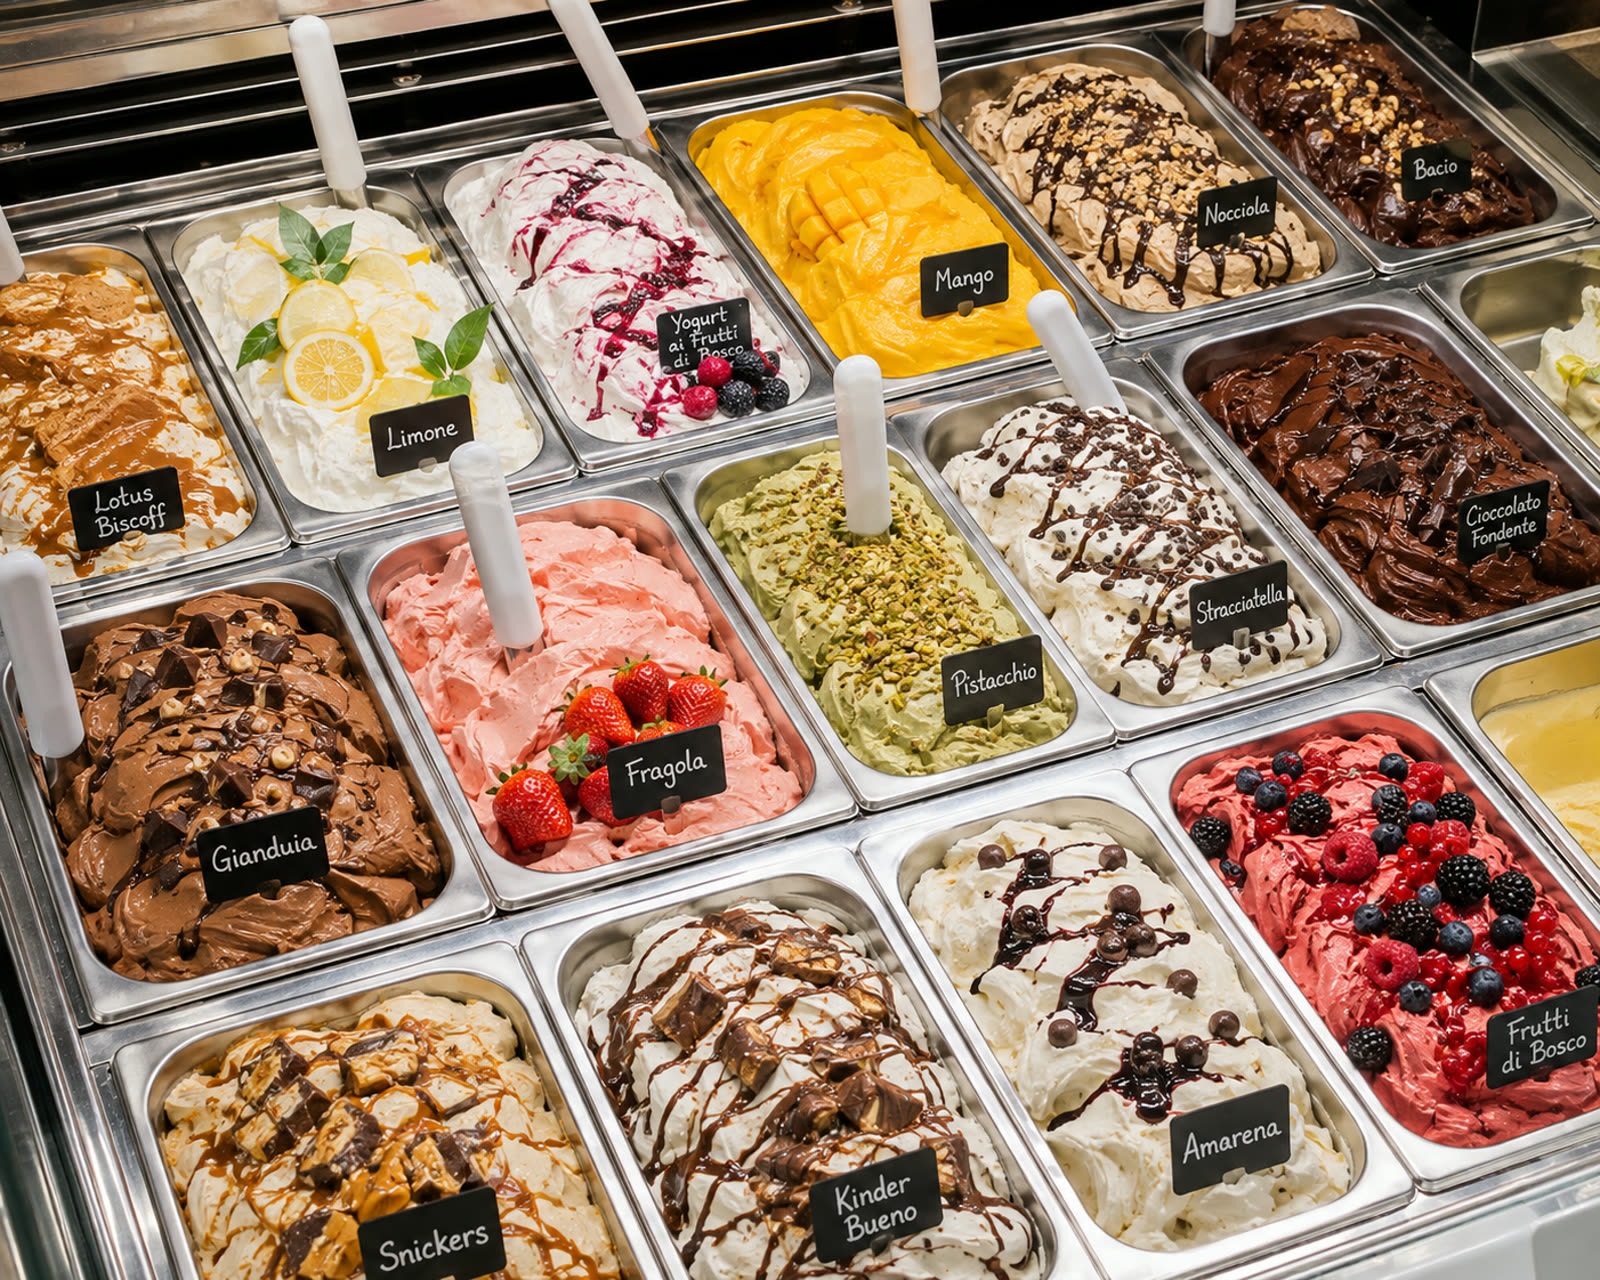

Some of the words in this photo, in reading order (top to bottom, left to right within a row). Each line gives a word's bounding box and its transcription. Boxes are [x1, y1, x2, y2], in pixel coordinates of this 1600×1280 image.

[1413, 157, 1458, 180] Bacio
[1205, 195, 1270, 226] Nocciola
[935, 267, 994, 295] Mango
[670, 305, 728, 335] Yogurt
[668, 338, 685, 353] ai
[689, 324, 739, 348] Frutti
[673, 353, 690, 369] di
[387, 423, 459, 451] Limone
[94, 486, 154, 514] Lotus
[1466, 492, 1541, 527] Cioccolato
[94, 502, 166, 538] Biscoff
[1471, 517, 1537, 549] Fondente
[1196, 583, 1285, 625] Stracciatella
[951, 662, 1037, 698] Pistacchio
[625, 748, 708, 788] Fragola
[211, 834, 318, 872] Gianduia
[1507, 1007, 1570, 1045] Frutti
[1501, 1051, 1523, 1074] di
[1529, 1034, 1587, 1065] Bosco
[1182, 1122, 1283, 1164] Amarena
[834, 1174, 911, 1215] Kinder
[843, 1205, 918, 1243] Bueno
[379, 1225, 490, 1272] Snickers
